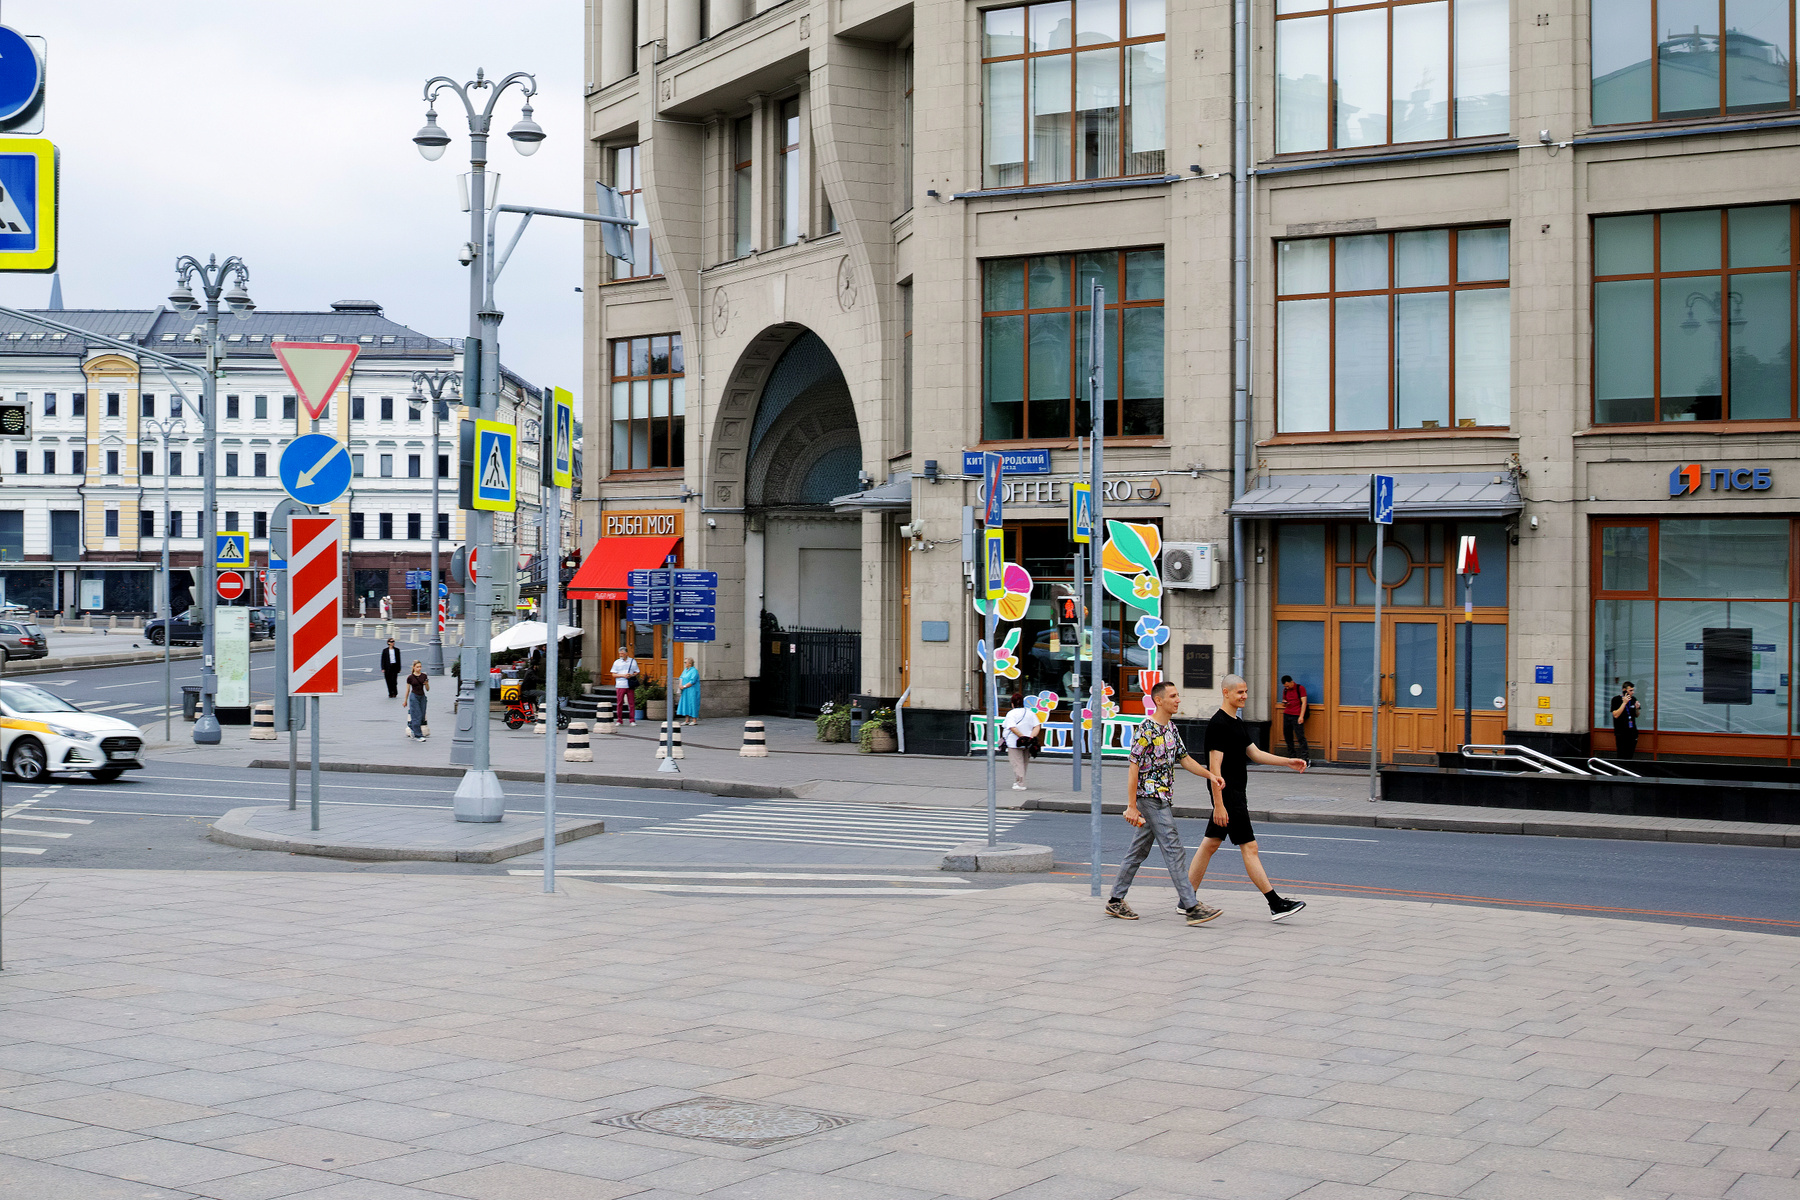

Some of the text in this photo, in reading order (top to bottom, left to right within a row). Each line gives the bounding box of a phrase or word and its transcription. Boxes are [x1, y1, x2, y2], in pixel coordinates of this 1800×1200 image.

[966, 454, 1045, 465] КИТОРОДСКИЙ
[1710, 468, 1772, 490] ПСБ
[1102, 479, 1132, 501] RO
[607, 515, 675, 535] РЫБА МОЯ
